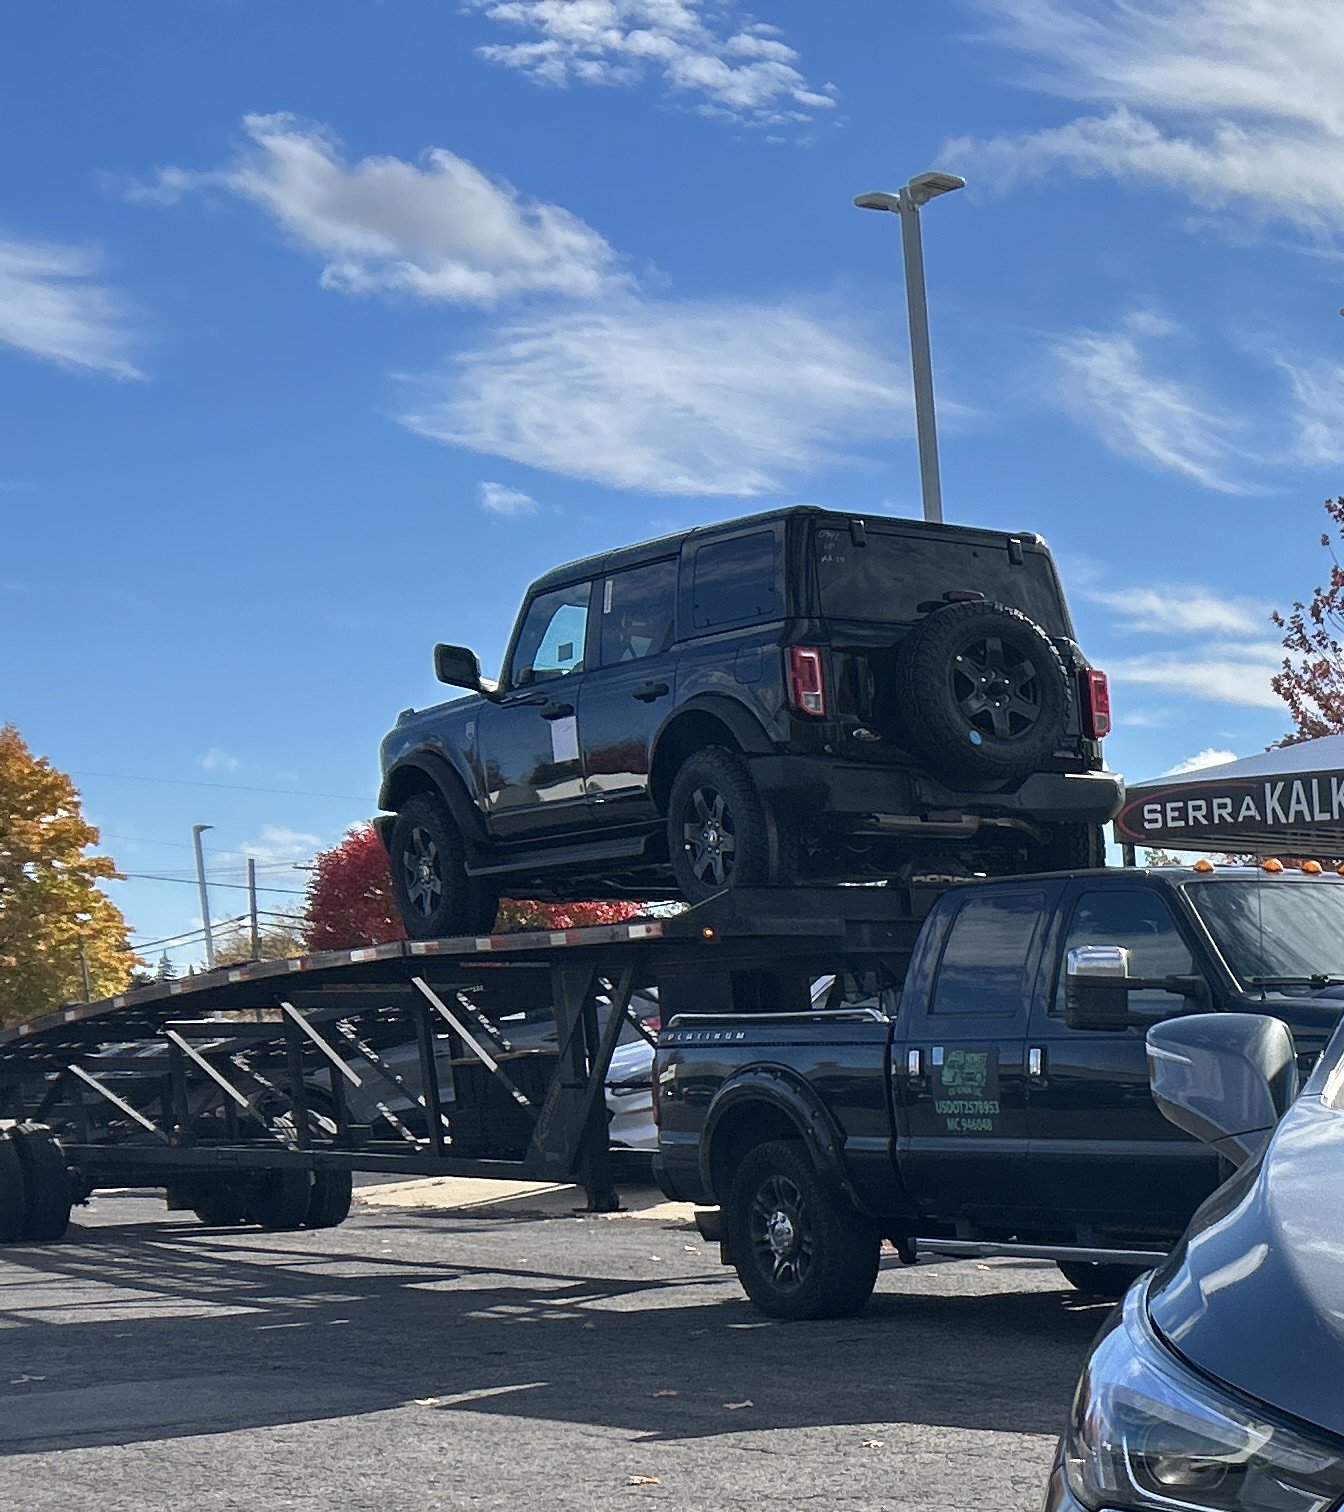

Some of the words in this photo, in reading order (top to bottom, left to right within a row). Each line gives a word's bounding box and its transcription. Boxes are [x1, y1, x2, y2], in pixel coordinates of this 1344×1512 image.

[1142, 795, 1262, 831] SERRA
[667, 1032, 745, 1041] PLATINUM
[946, 1117, 961, 1131] MC
